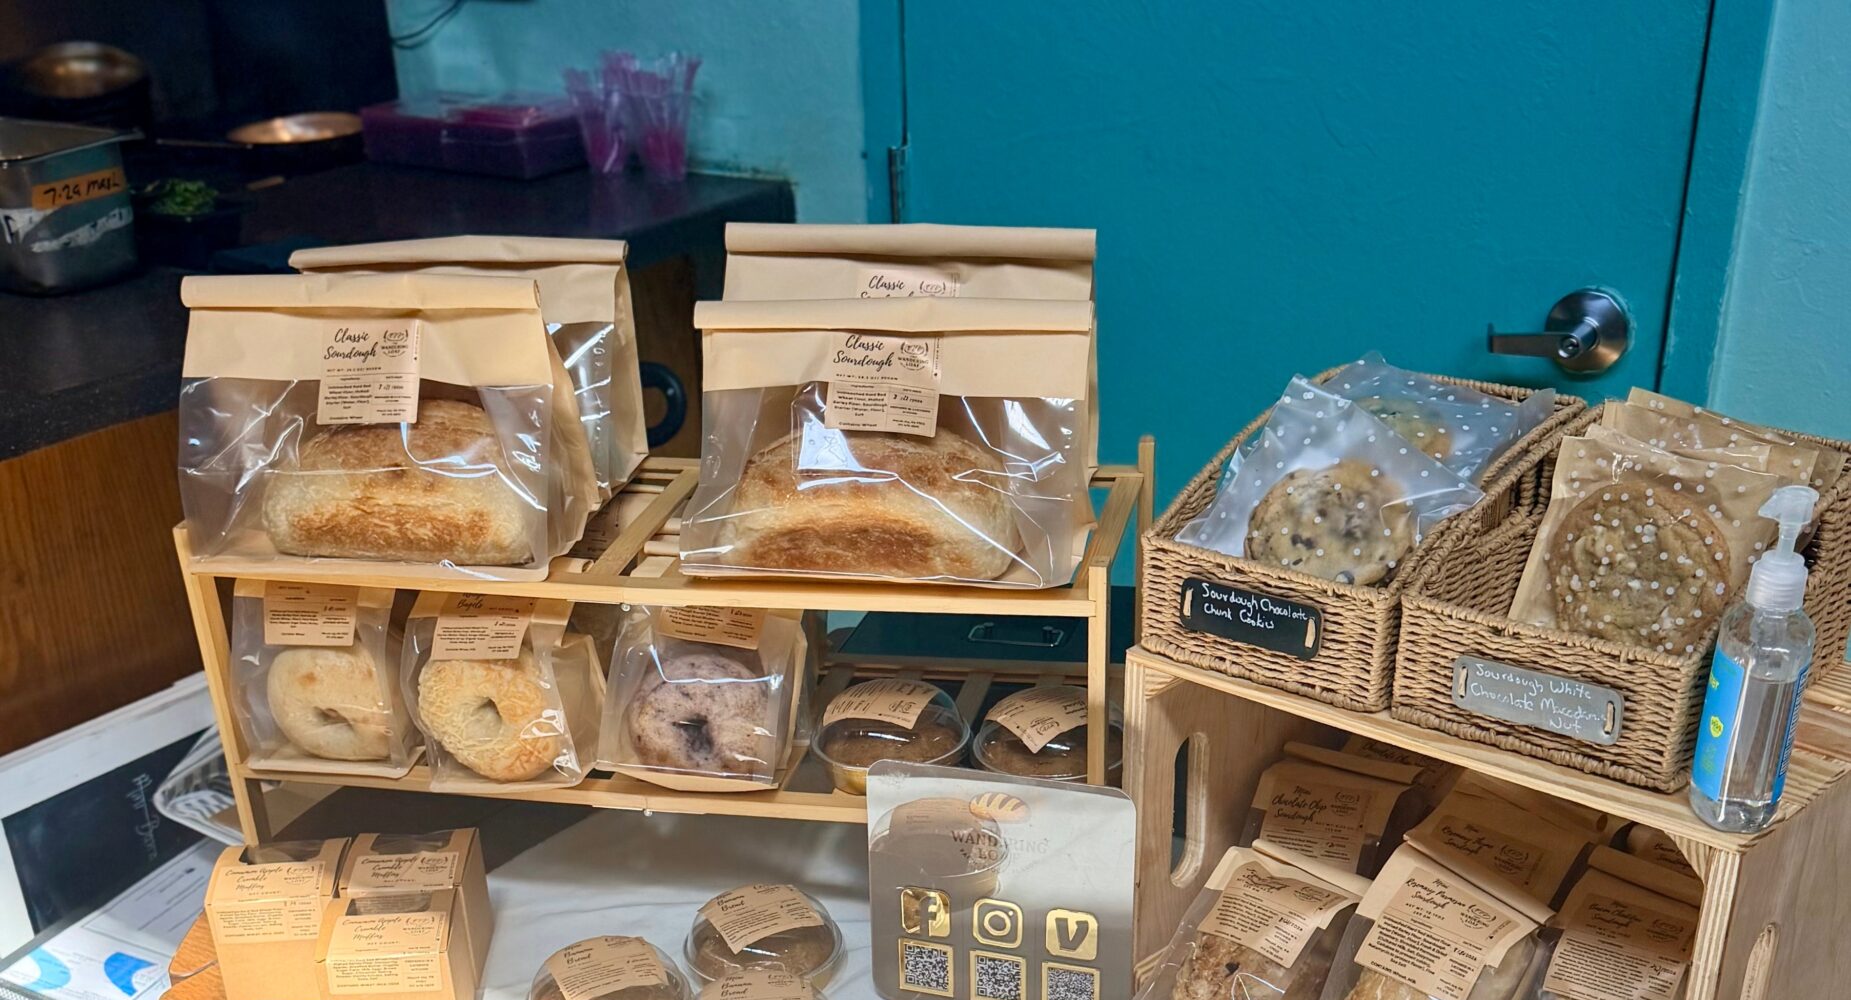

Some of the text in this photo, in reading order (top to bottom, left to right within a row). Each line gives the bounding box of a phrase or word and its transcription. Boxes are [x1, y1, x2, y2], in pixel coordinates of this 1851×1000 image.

[869, 275, 905, 290] Classic
[334, 328, 370, 343] Classic
[845, 334, 884, 351] Classic
[324, 342, 378, 363] Sourdough
[833, 350, 895, 372] Sourdough
[1202, 582, 1308, 621] Sourdough Chocolate
[1203, 603, 1232, 620] Chunk
[1476, 663, 1592, 700] Sourdough White
[1550, 717, 1582, 733] Nut
[1406, 878, 1436, 896] Rosemary
[1411, 891, 1450, 909] Sourdough
